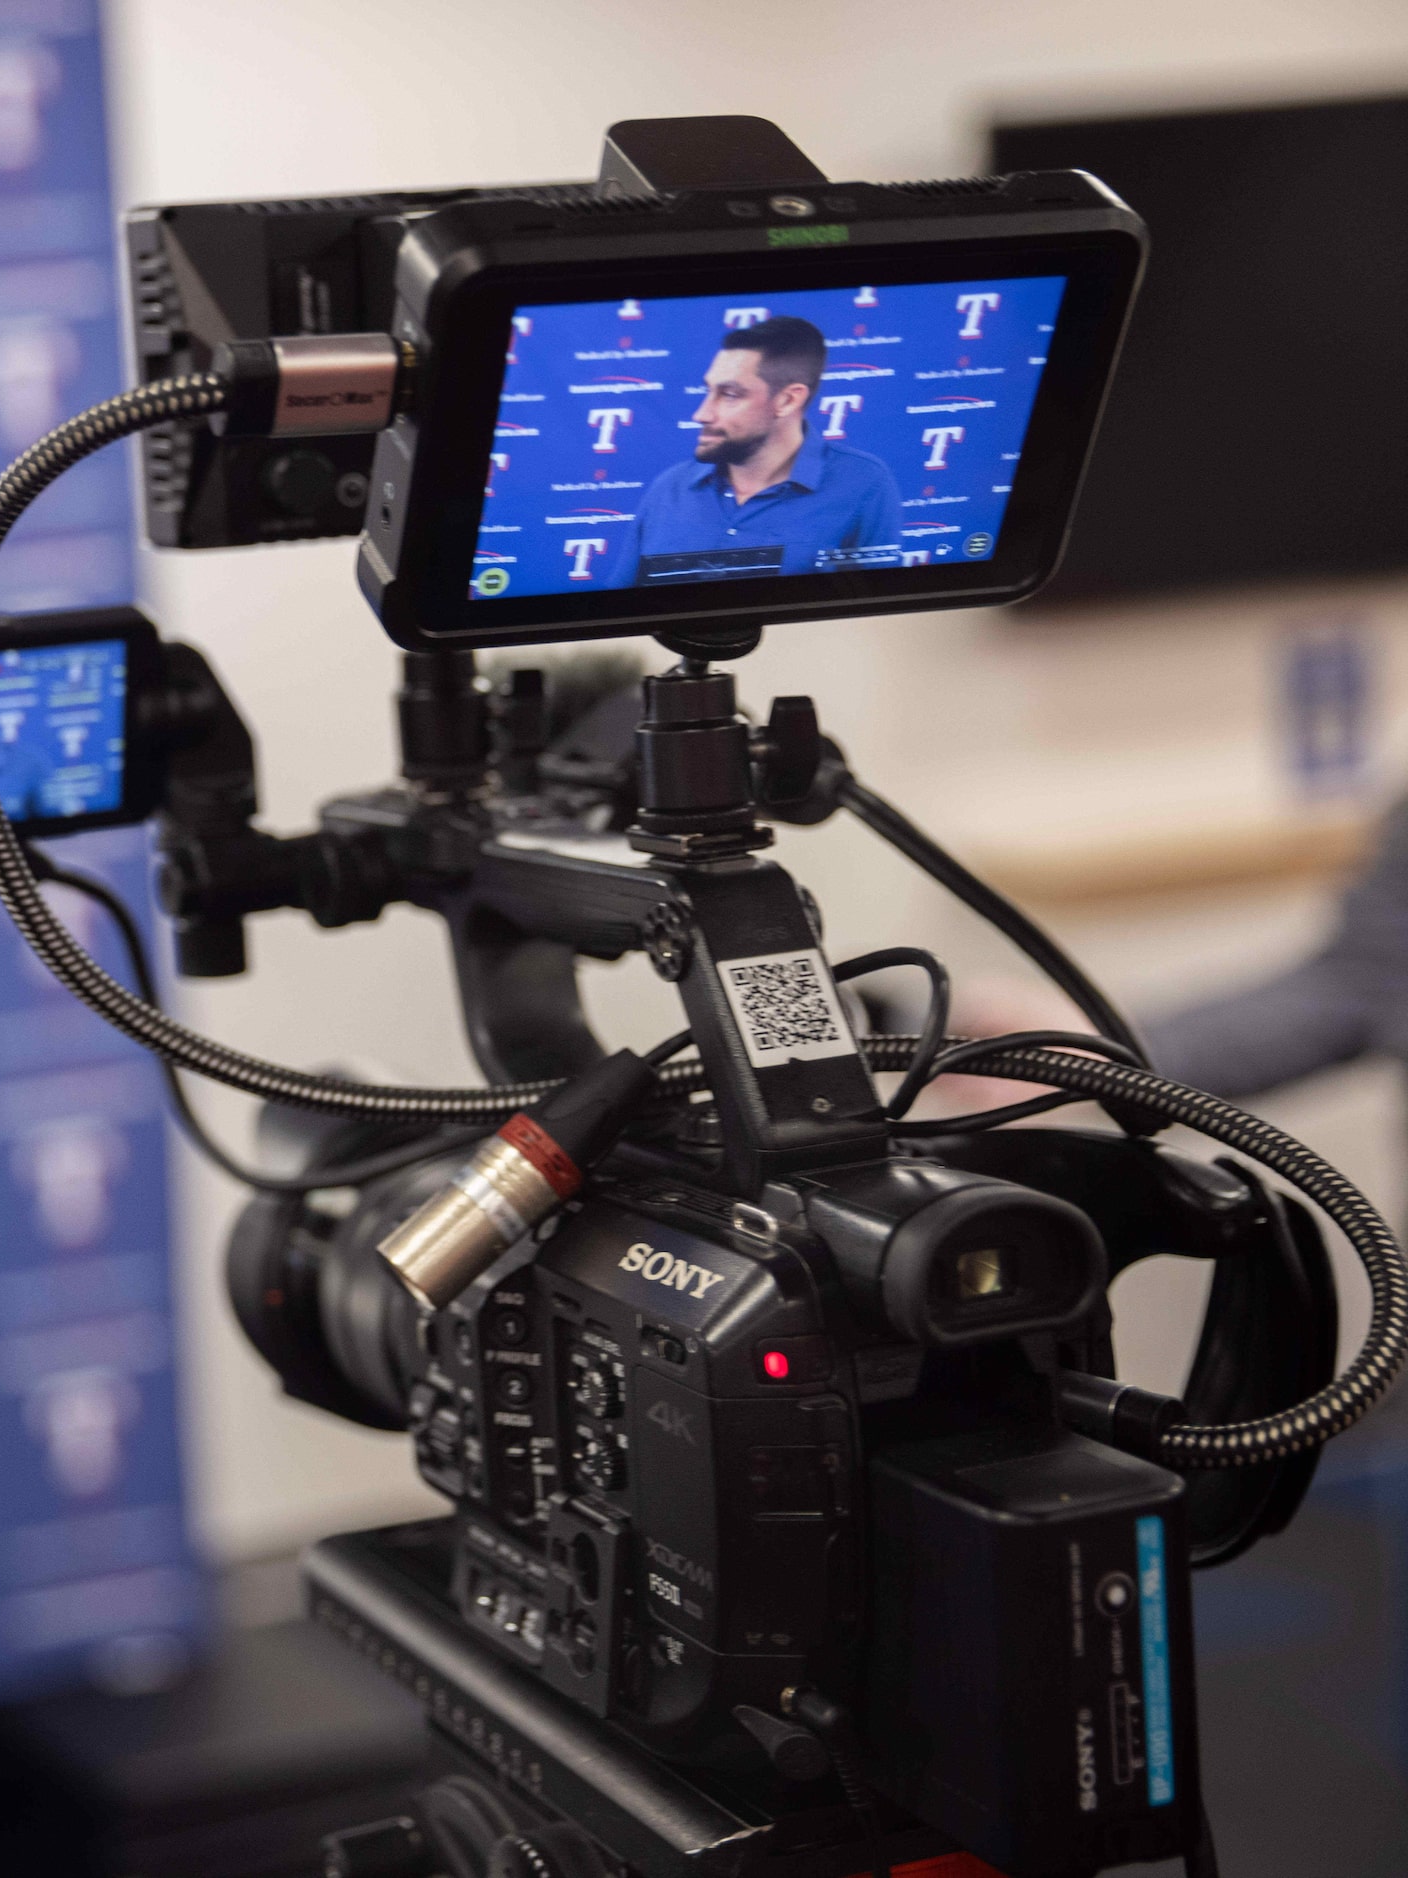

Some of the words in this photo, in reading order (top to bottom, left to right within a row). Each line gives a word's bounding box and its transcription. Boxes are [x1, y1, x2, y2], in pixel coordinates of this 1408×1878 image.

[618, 1242, 726, 1299] SONY
[508, 1379, 523, 1396] 2
[1077, 1725, 1097, 1811] SONY
